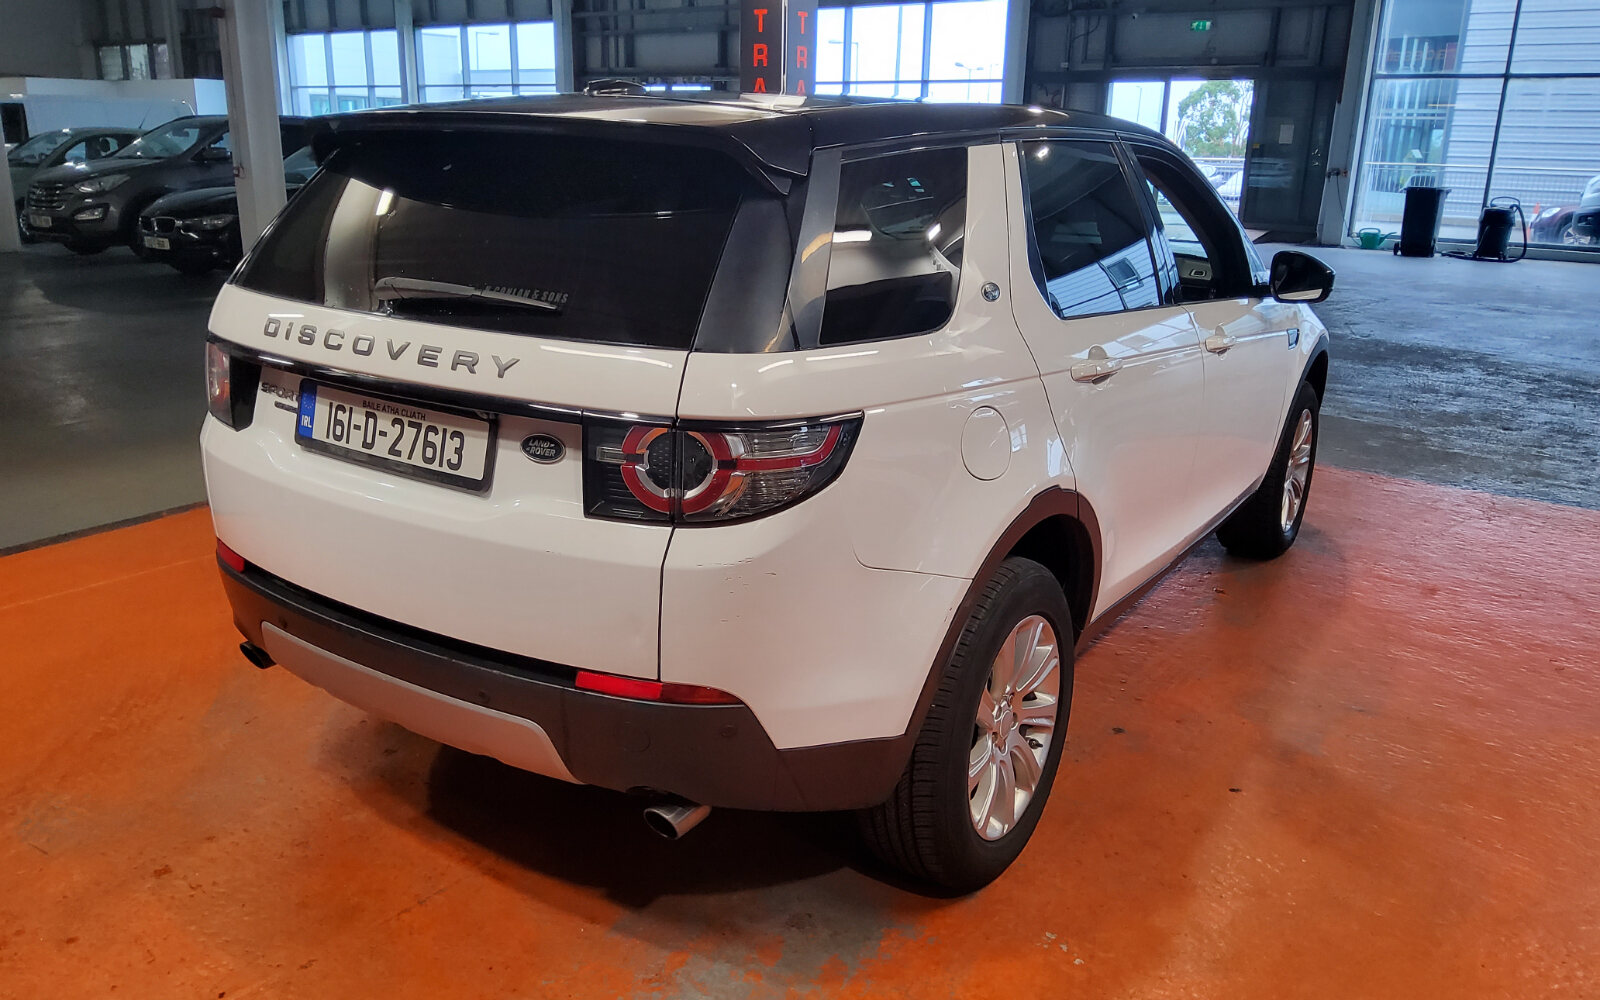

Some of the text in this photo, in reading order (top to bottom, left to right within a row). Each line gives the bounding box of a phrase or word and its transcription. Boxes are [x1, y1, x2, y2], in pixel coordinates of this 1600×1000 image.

[531, 289, 540, 300] &
[541, 291, 569, 304] SONS
[263, 317, 521, 379] DISCOVERY
[362, 400, 381, 411] BAILE
[401, 408, 426, 421] CLIATH
[301, 414, 313, 429] IRL
[325, 401, 465, 471] 161-D-27613
[528, 439, 550, 448] LAND
[530, 446, 556, 457] ROVER
